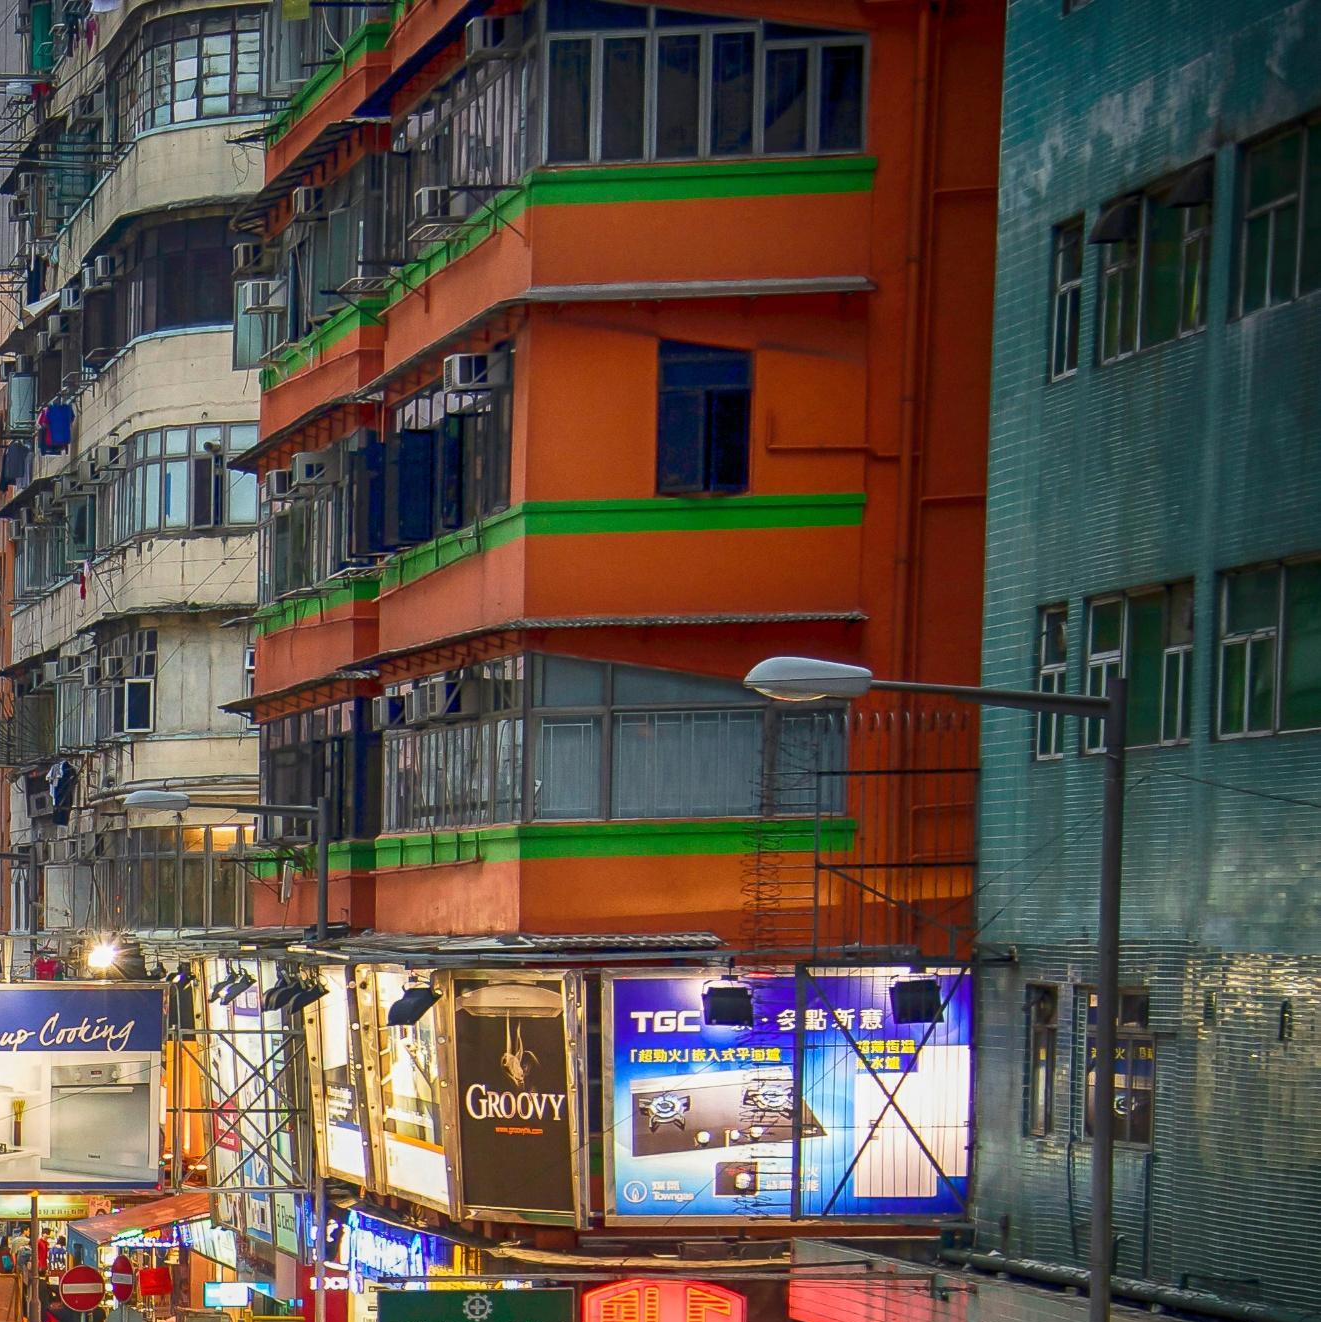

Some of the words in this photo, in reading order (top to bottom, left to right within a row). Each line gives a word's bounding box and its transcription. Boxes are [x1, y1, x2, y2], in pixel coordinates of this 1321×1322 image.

[39, 1013, 137, 1052] Cooking
[630, 1009, 702, 1033] TGC
[465, 1084, 566, 1122] GROOVY
[652, 1191, 696, 1203] Towngas
